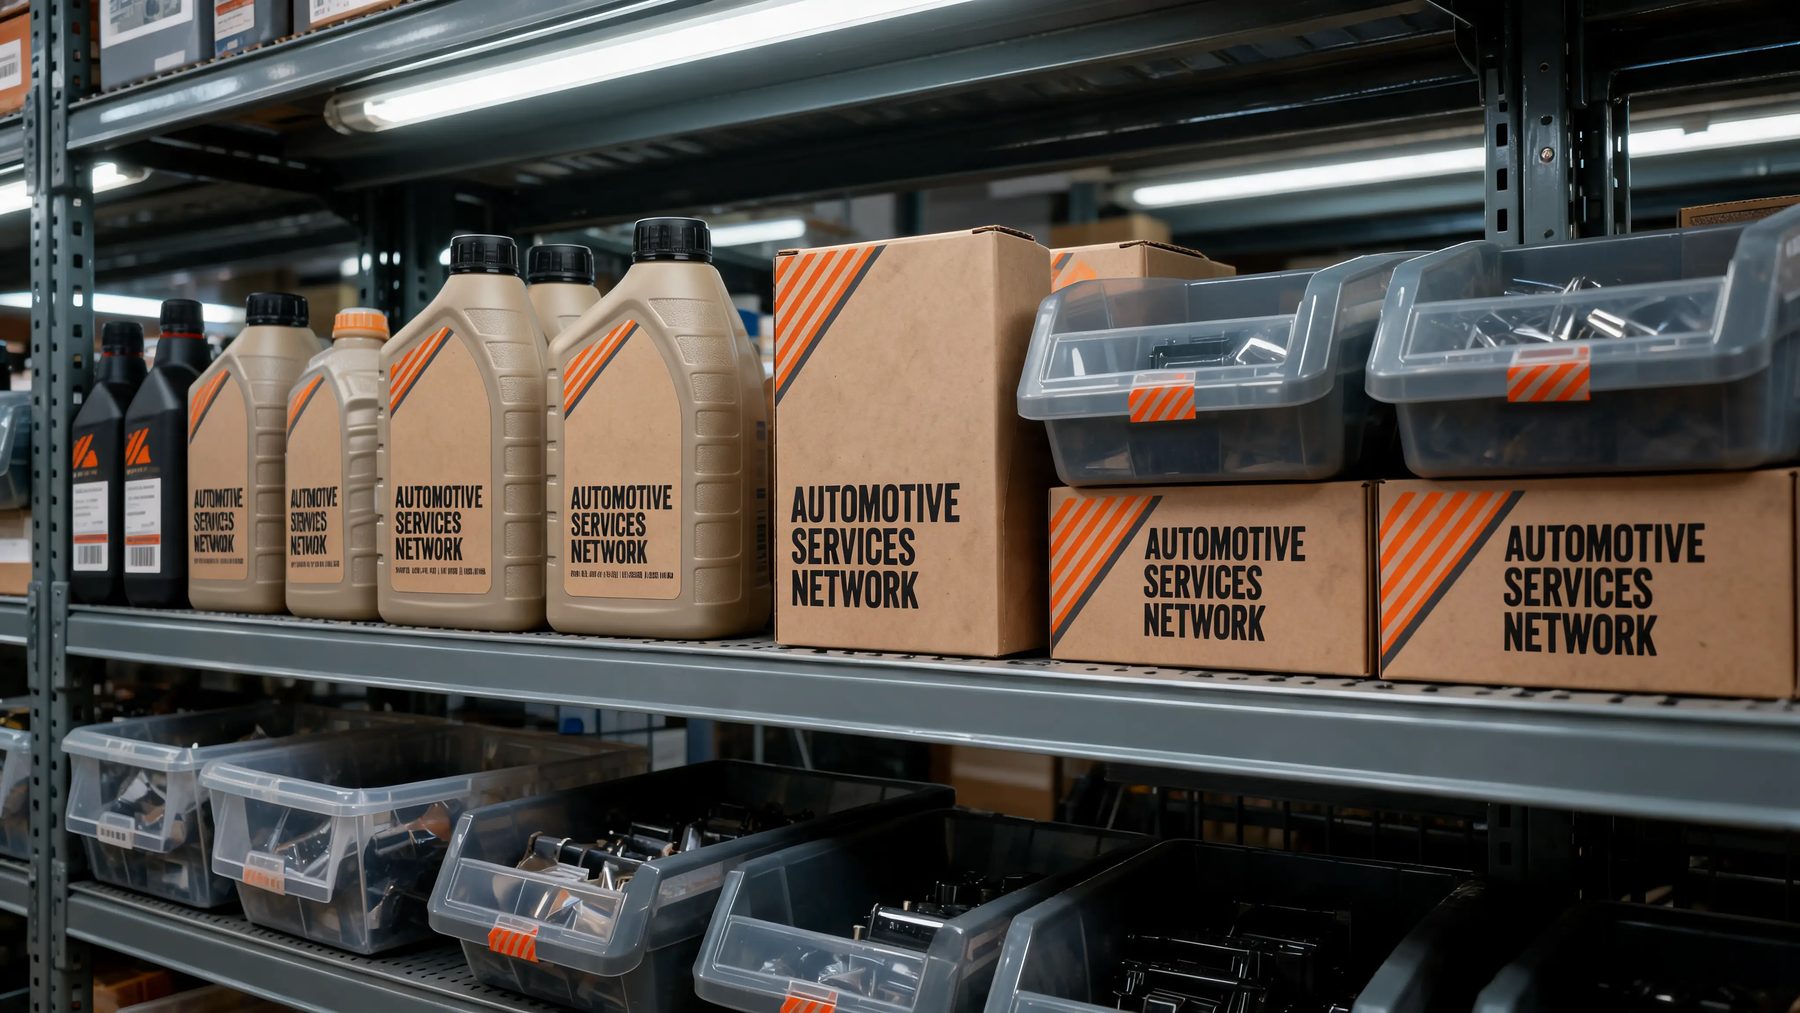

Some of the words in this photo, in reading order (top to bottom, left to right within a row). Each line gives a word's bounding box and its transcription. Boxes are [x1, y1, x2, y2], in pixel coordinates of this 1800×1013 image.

[395, 485, 483, 509] AUTOMOTIVE
[570, 484, 673, 510] AUTOMOTIVE
[790, 482, 961, 524] AUTOMOTIVE
[395, 511, 462, 535] SERVICES
[571, 511, 647, 538] SERVICES
[395, 536, 464, 561] NETWORK
[571, 539, 648, 565] NETWORK
[791, 527, 916, 567] SERVICES
[1144, 525, 1306, 562] AUTOMOTIVE
[1503, 522, 1706, 564] AUTOMOTIVE
[791, 569, 919, 610] NETWORK
[1143, 563, 1263, 601] SERVICES
[1503, 566, 1654, 610] SERVICES
[1143, 602, 1266, 642] NETWORK
[1503, 611, 1658, 657] NETWORK
